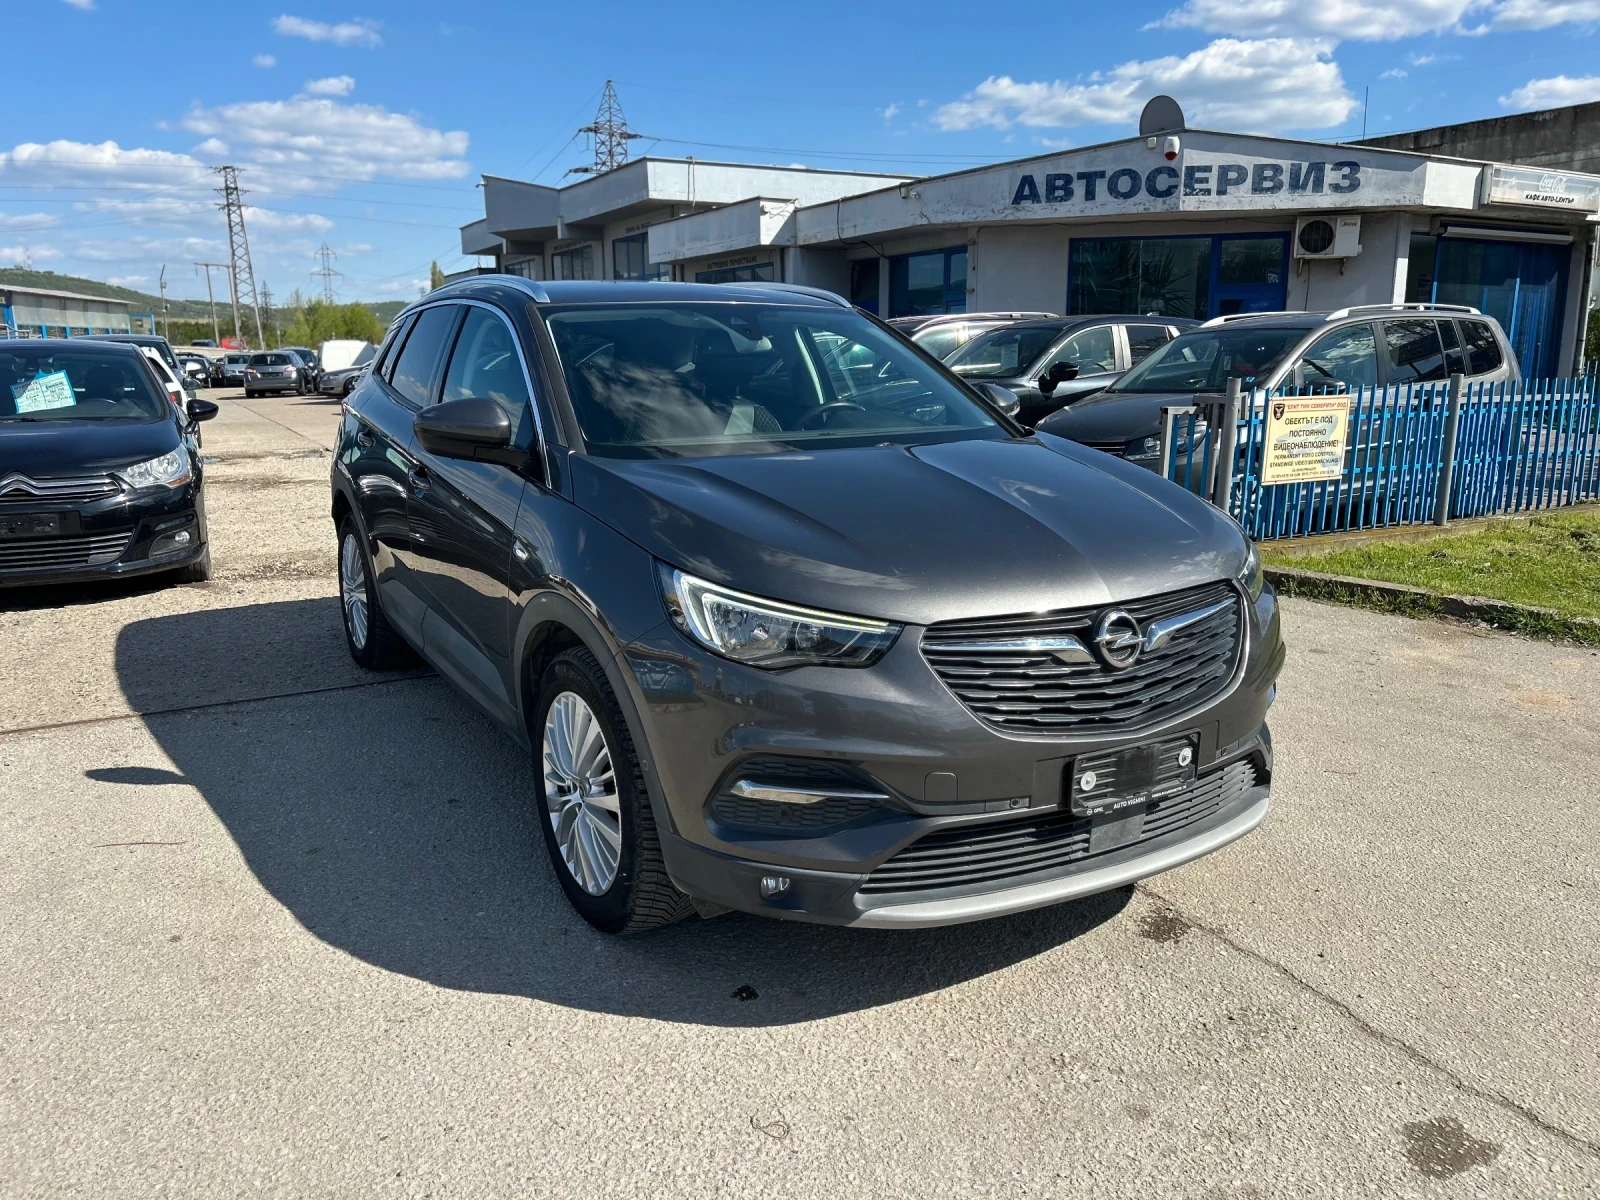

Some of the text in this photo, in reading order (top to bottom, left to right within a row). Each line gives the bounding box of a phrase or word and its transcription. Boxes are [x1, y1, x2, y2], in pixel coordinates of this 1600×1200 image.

[1011, 160, 1362, 206] АВТОСЕРВИЗ
[1541, 194, 1575, 204] АВТО-ЦЕНТЪР
[1285, 416, 1315, 425] ОБЕКТЪТ
[1320, 416, 1333, 424] ПОД
[1288, 428, 1327, 438] ПОСТОЯННО
[1273, 440, 1339, 451] ВИДЕОНАБЛЮДЕНИЕ!
[1113, 801, 1127, 810] AUTO
